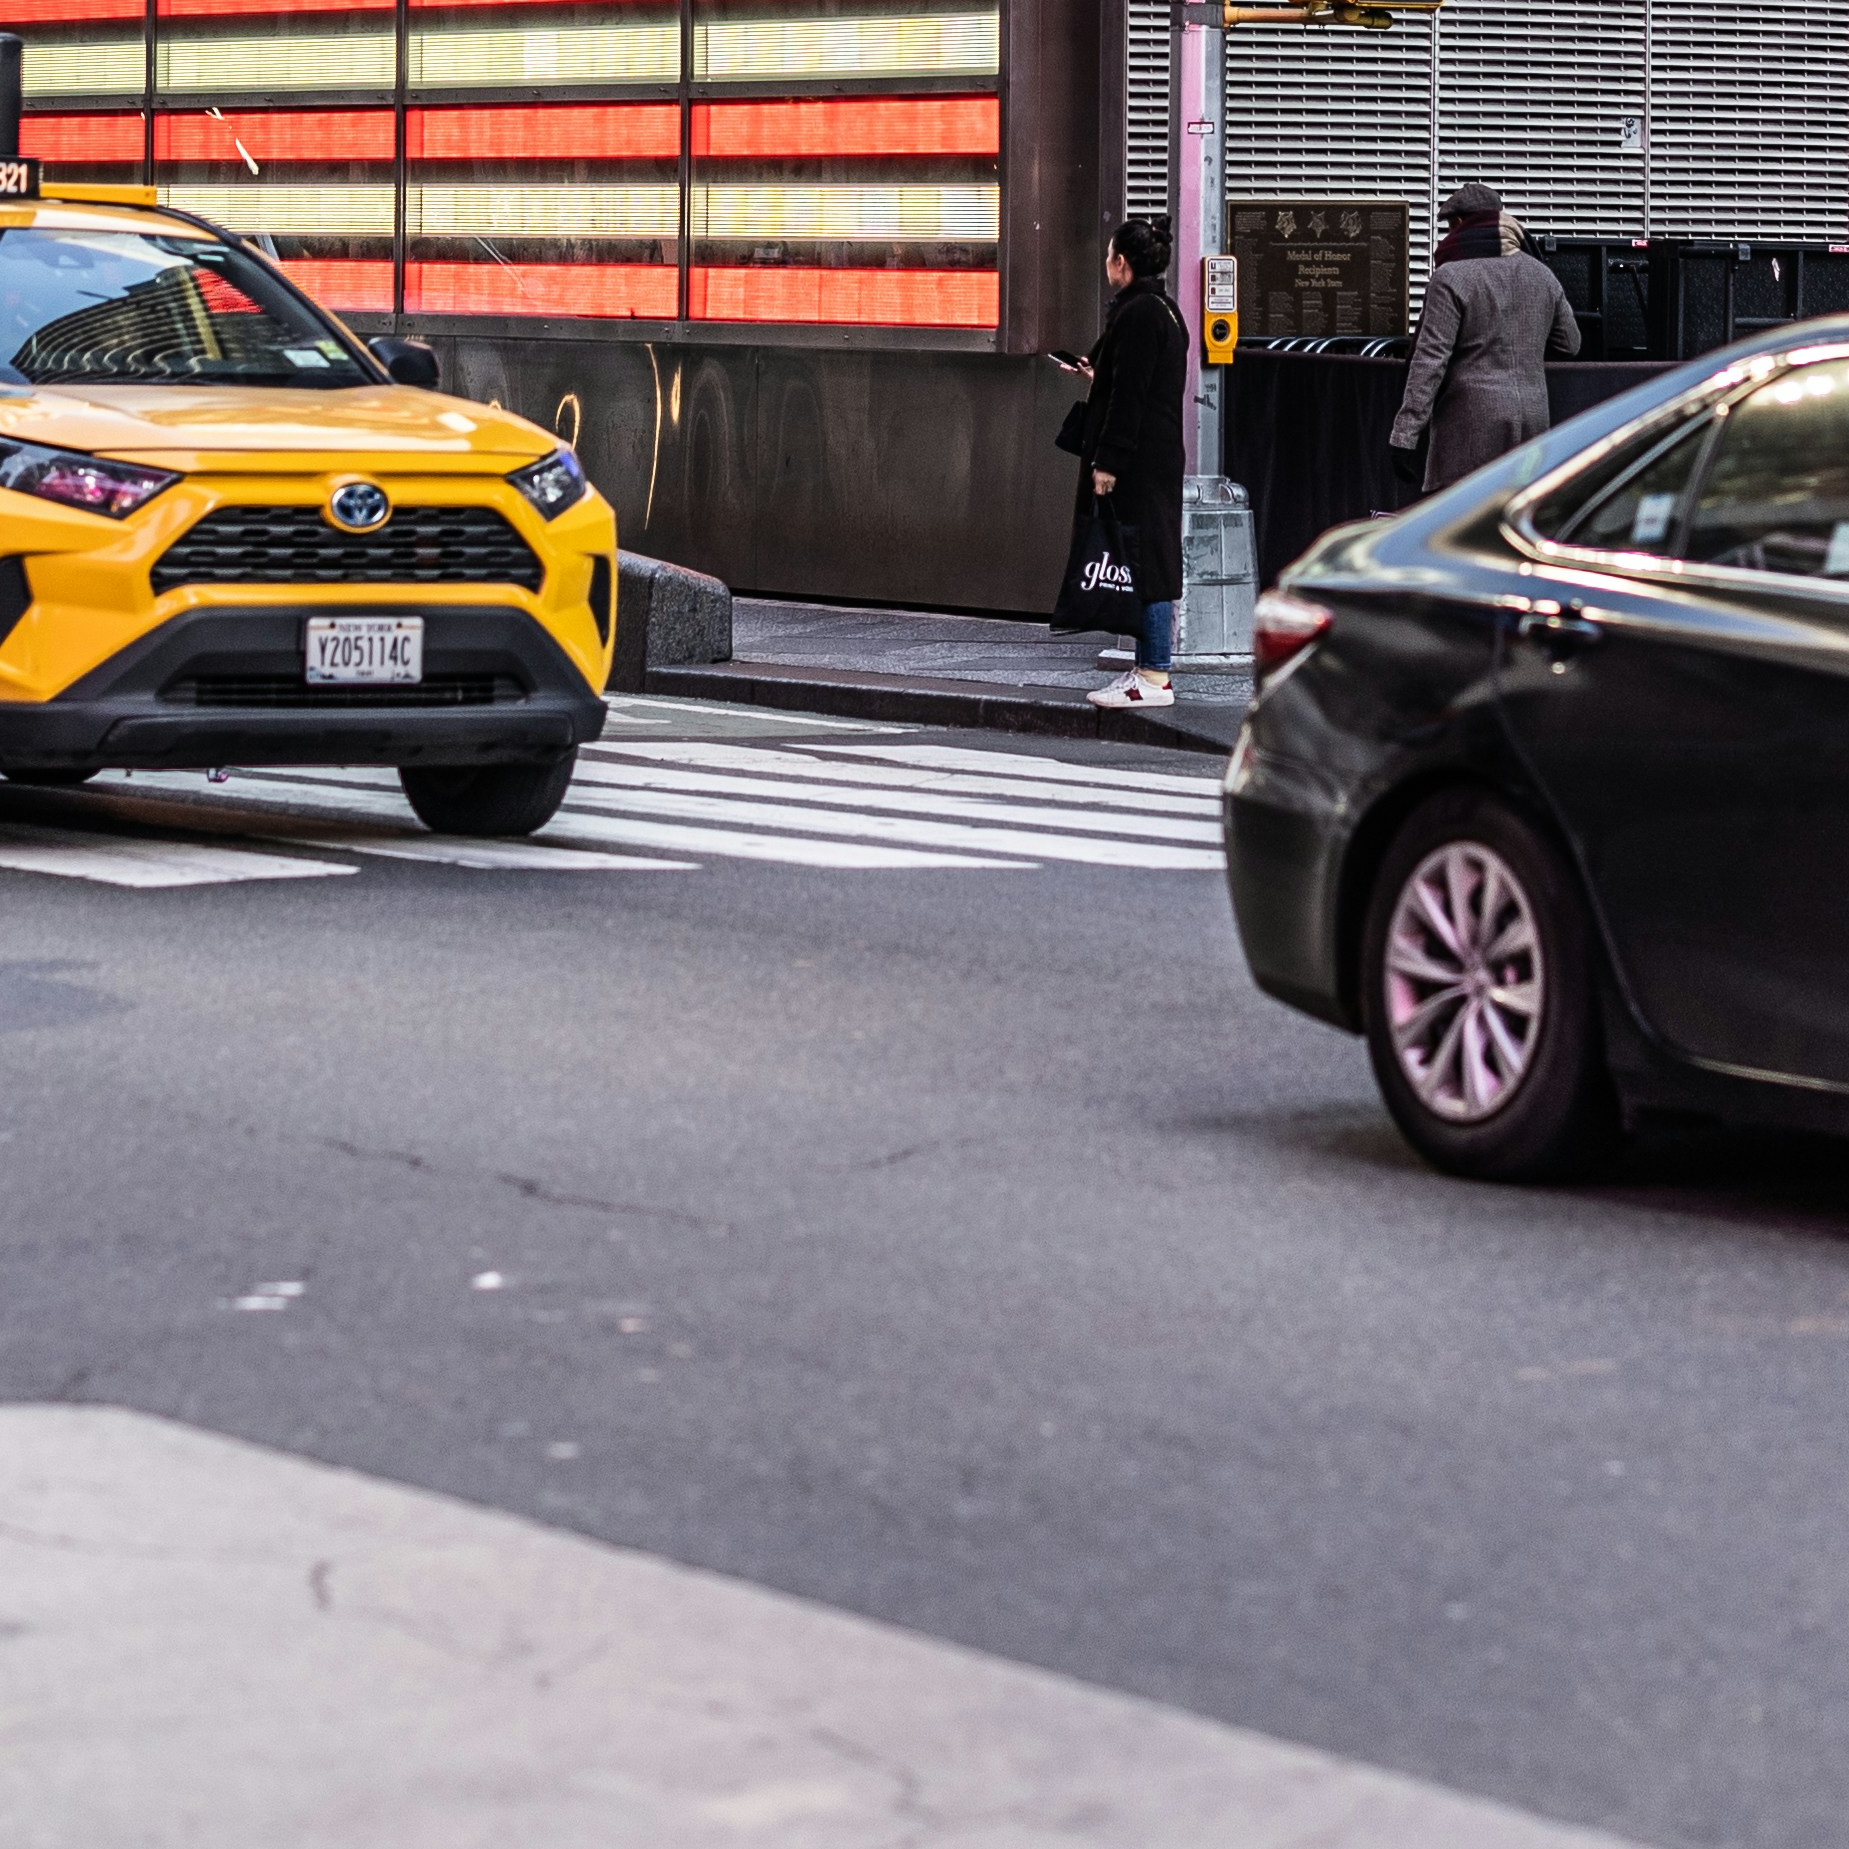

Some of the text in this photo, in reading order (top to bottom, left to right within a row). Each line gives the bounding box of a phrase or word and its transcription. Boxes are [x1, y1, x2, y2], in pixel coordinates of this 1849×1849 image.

[1286, 250, 1352, 262] Medal of Honor
[1297, 264, 1340, 278] Recipients
[318, 635, 411, 668] Y205114C
